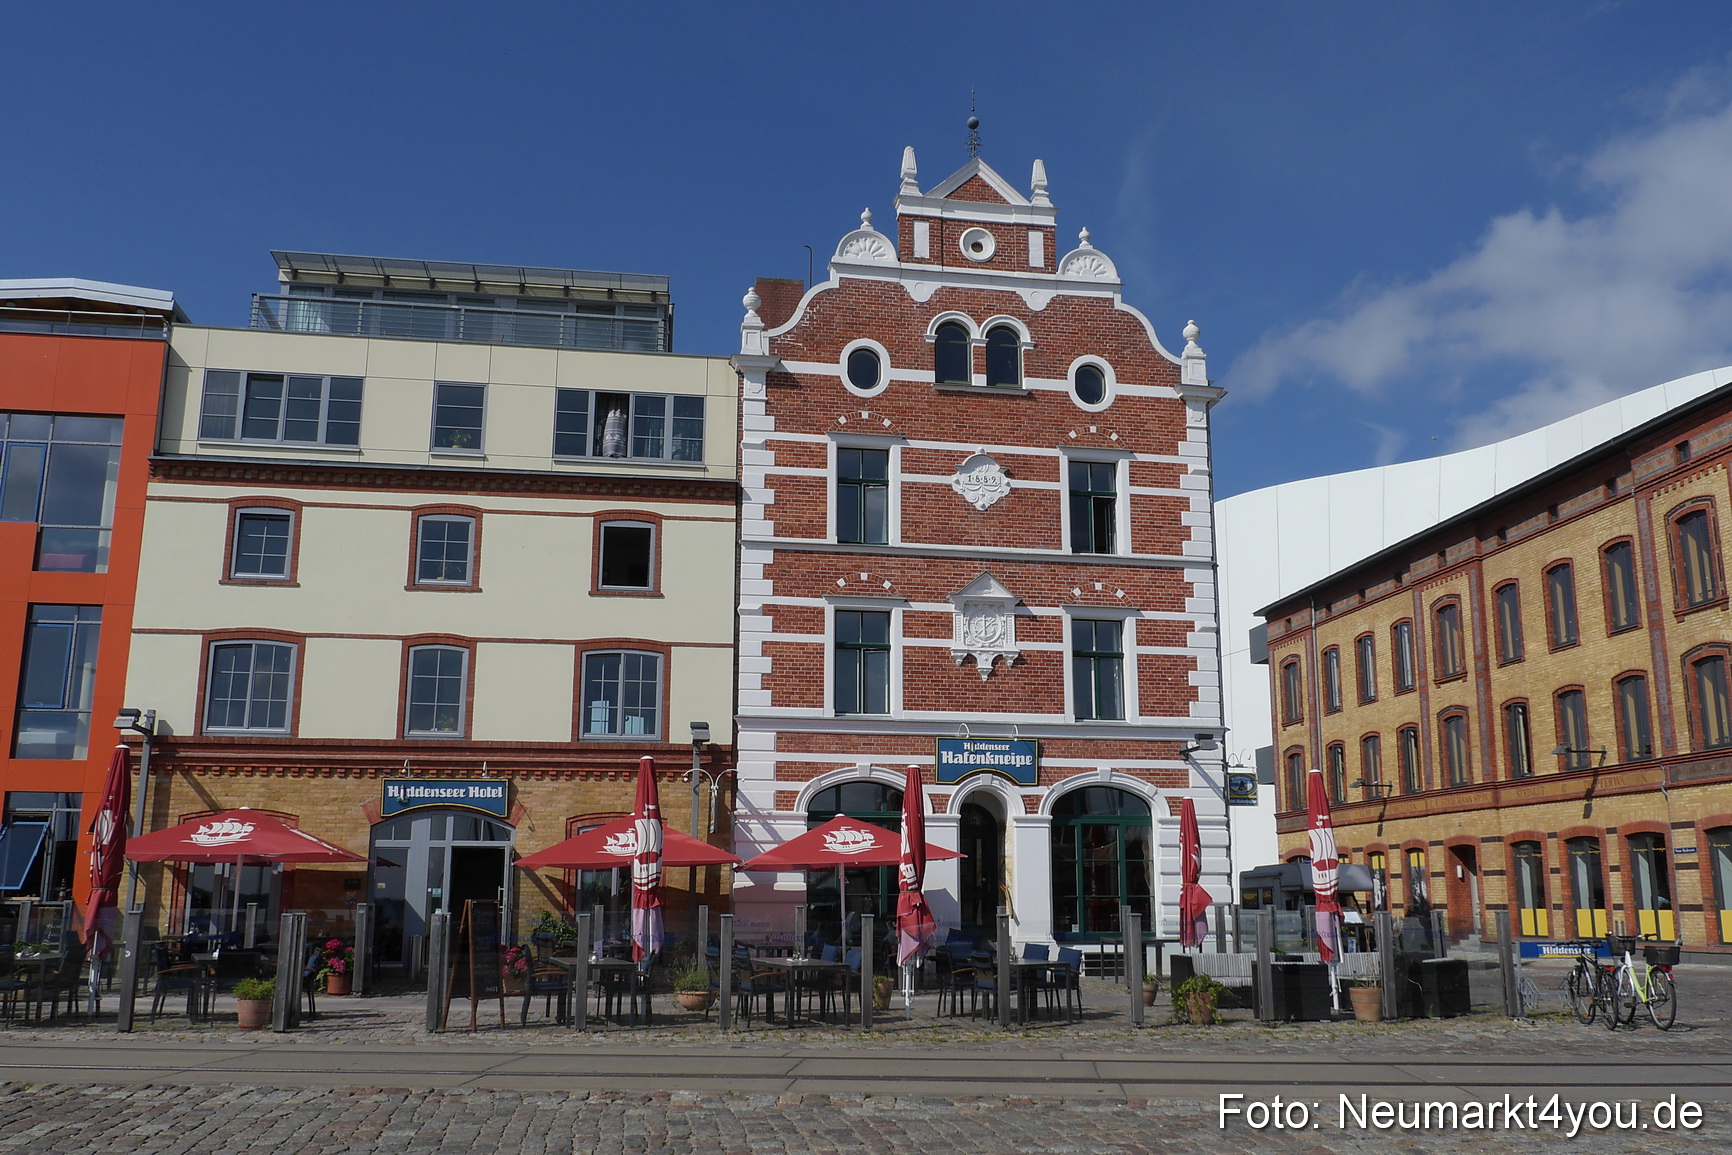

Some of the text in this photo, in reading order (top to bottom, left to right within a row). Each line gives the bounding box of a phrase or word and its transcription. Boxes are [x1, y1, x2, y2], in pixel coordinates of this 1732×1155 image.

[963, 742, 1010, 751] Hiddenseer
[941, 751, 1033, 767] Hafenkneipe
[387, 785, 503, 801] Hiddenseer Hotel
